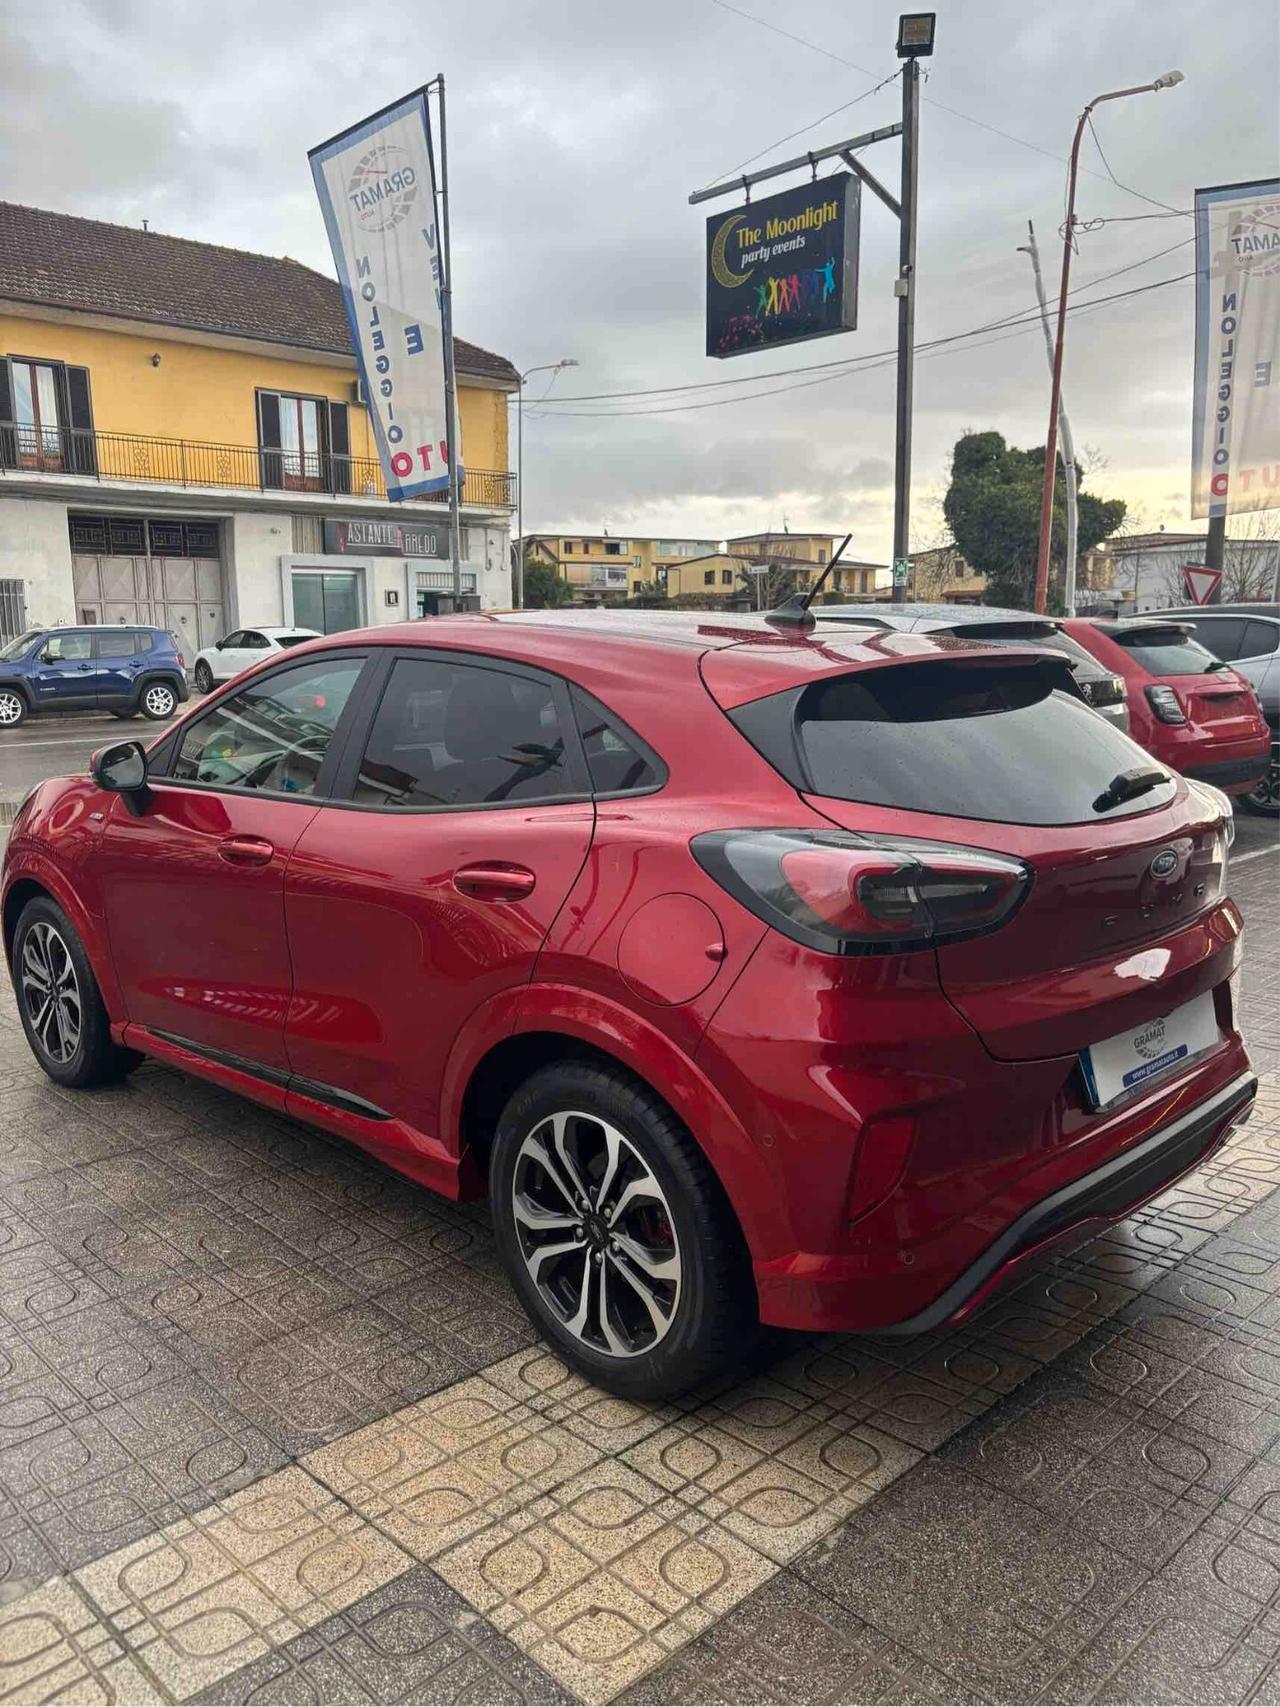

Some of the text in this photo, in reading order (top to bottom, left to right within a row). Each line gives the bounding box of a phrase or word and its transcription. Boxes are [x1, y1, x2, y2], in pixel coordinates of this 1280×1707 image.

[736, 200, 838, 249] The Moonlight
[740, 234, 806, 269] party events
[1133, 1025, 1166, 1048] GRAMAT
